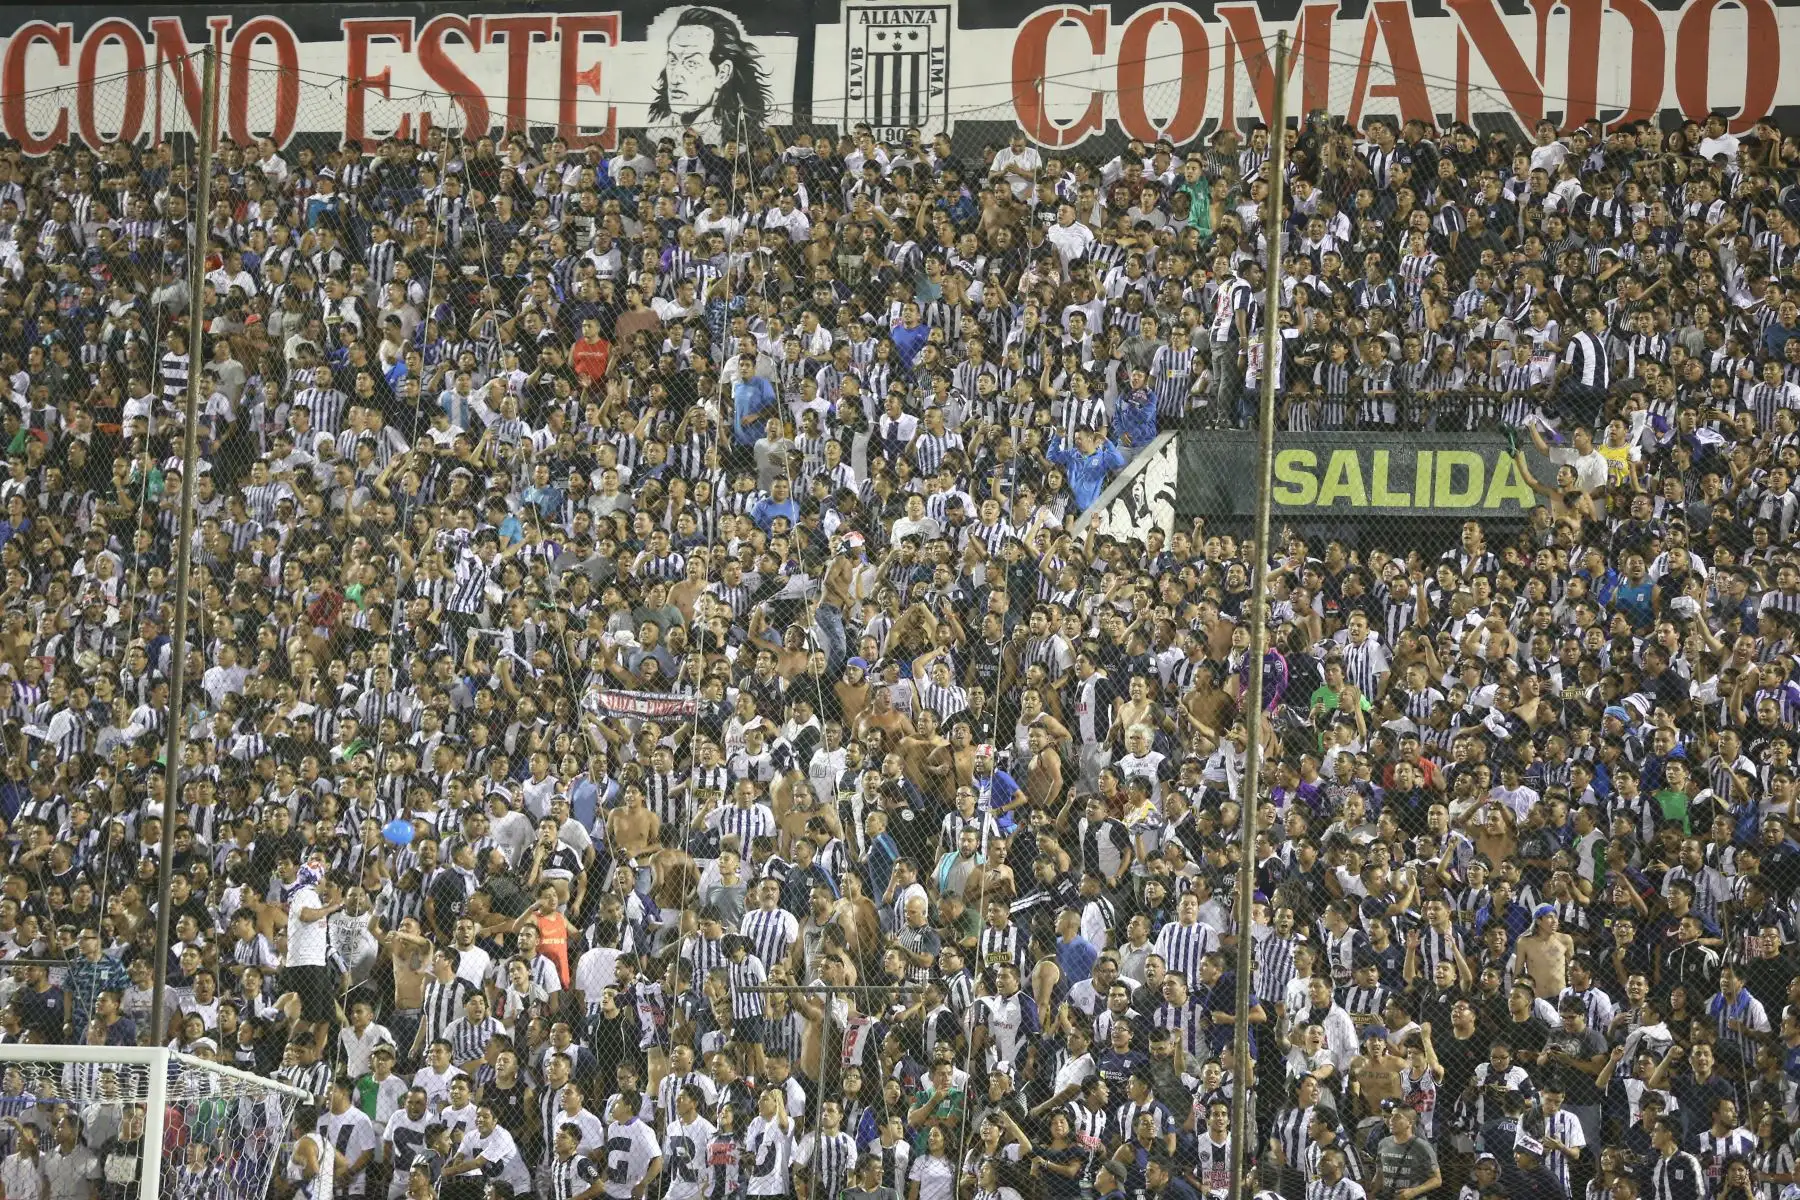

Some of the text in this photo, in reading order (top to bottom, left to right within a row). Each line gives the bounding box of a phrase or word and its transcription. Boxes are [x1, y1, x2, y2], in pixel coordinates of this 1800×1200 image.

[858, 9, 937, 25] ALIANZA
[1, 11, 622, 157] CONO ESTE
[930, 45, 944, 98] LIMA
[1010, 0, 1782, 150] COMANDO
[1272, 449, 1537, 508] SALIDA
[669, 1136, 699, 1183] R
